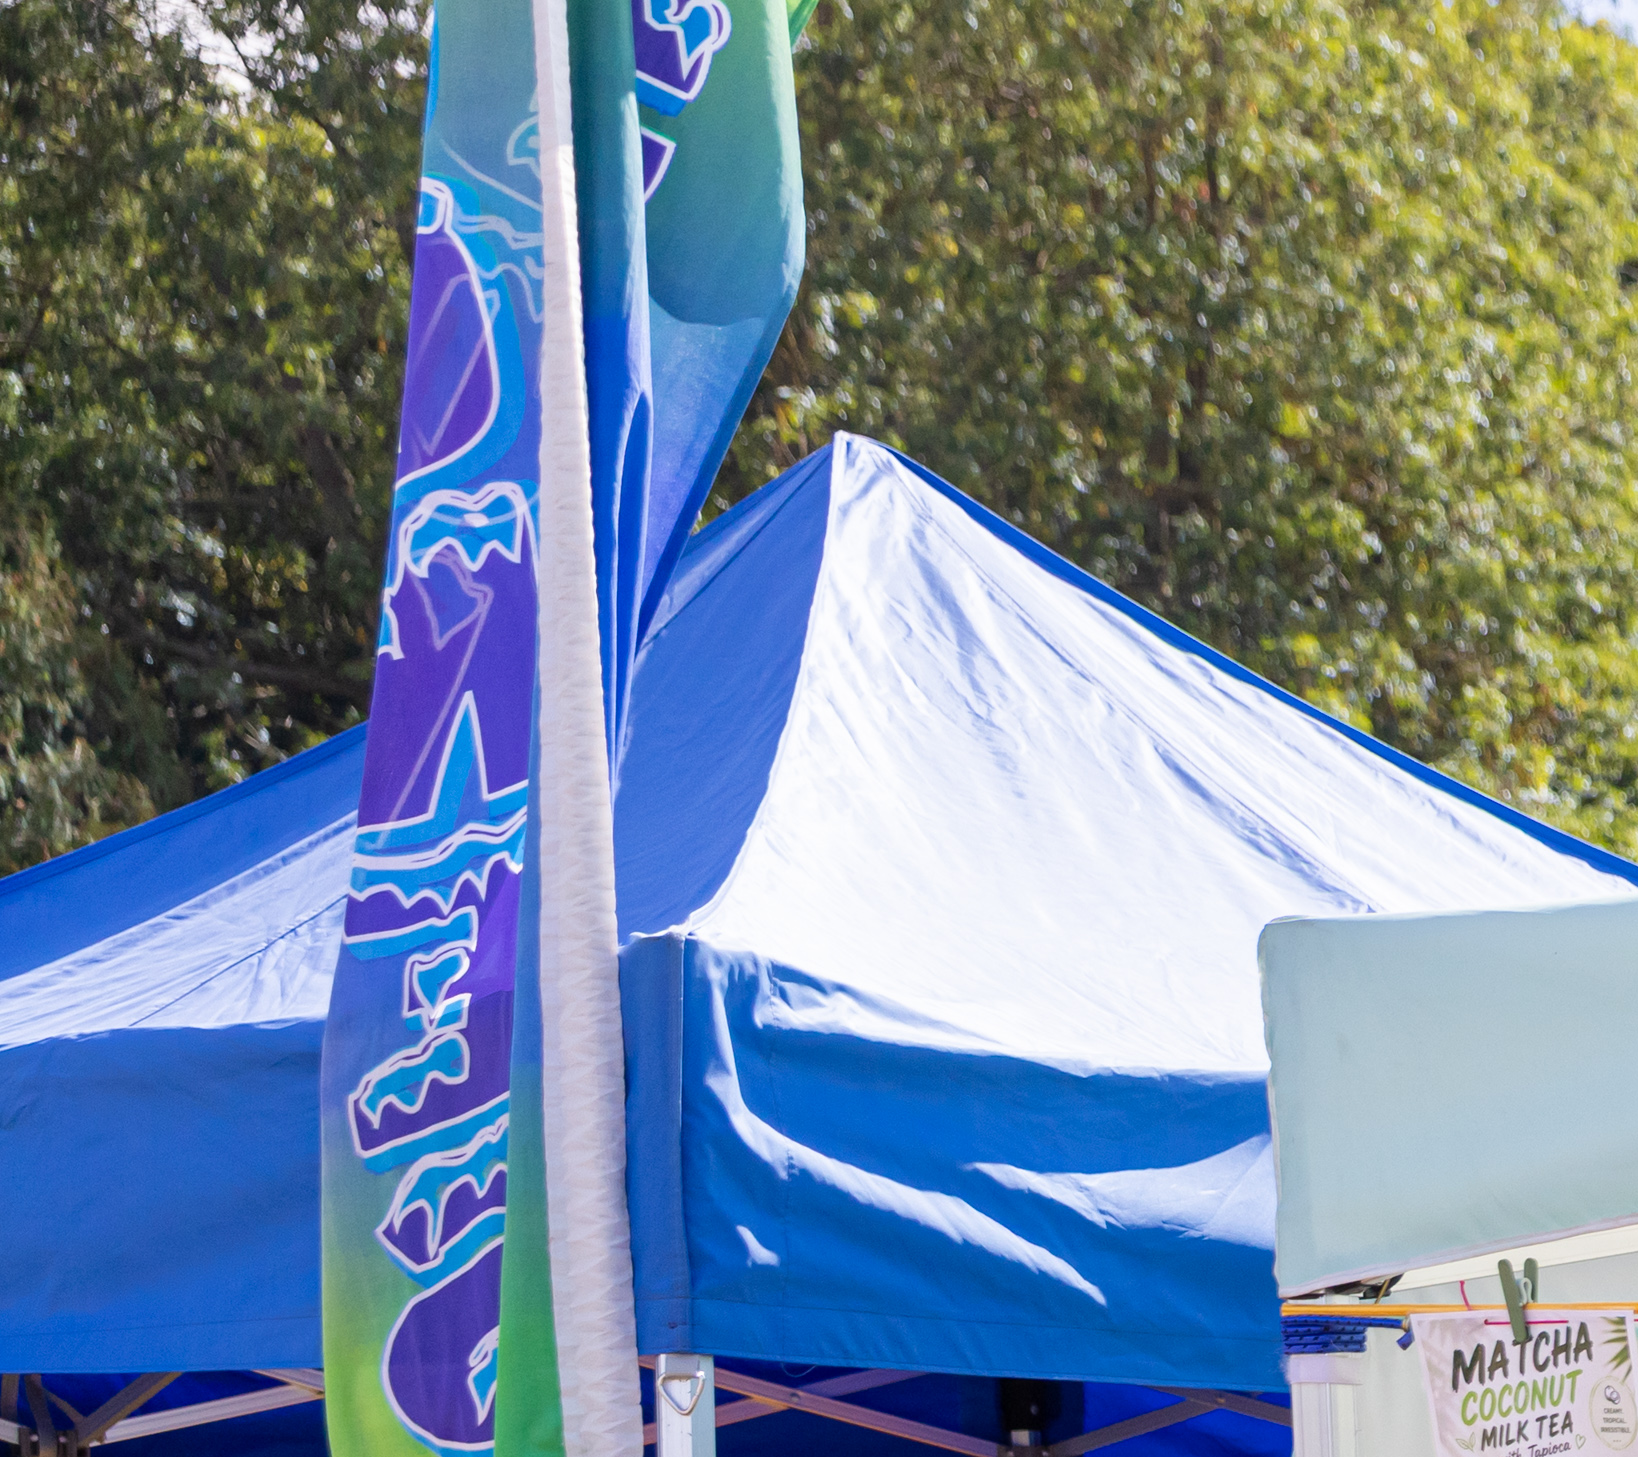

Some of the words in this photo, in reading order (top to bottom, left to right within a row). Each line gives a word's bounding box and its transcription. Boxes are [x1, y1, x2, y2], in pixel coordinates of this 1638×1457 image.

[1452, 1322, 1593, 1393] MATCHA
[1461, 1369, 1583, 1426] COCONUT
[1481, 1420, 1529, 1451] MILK
[1535, 1411, 1573, 1440] TEA
